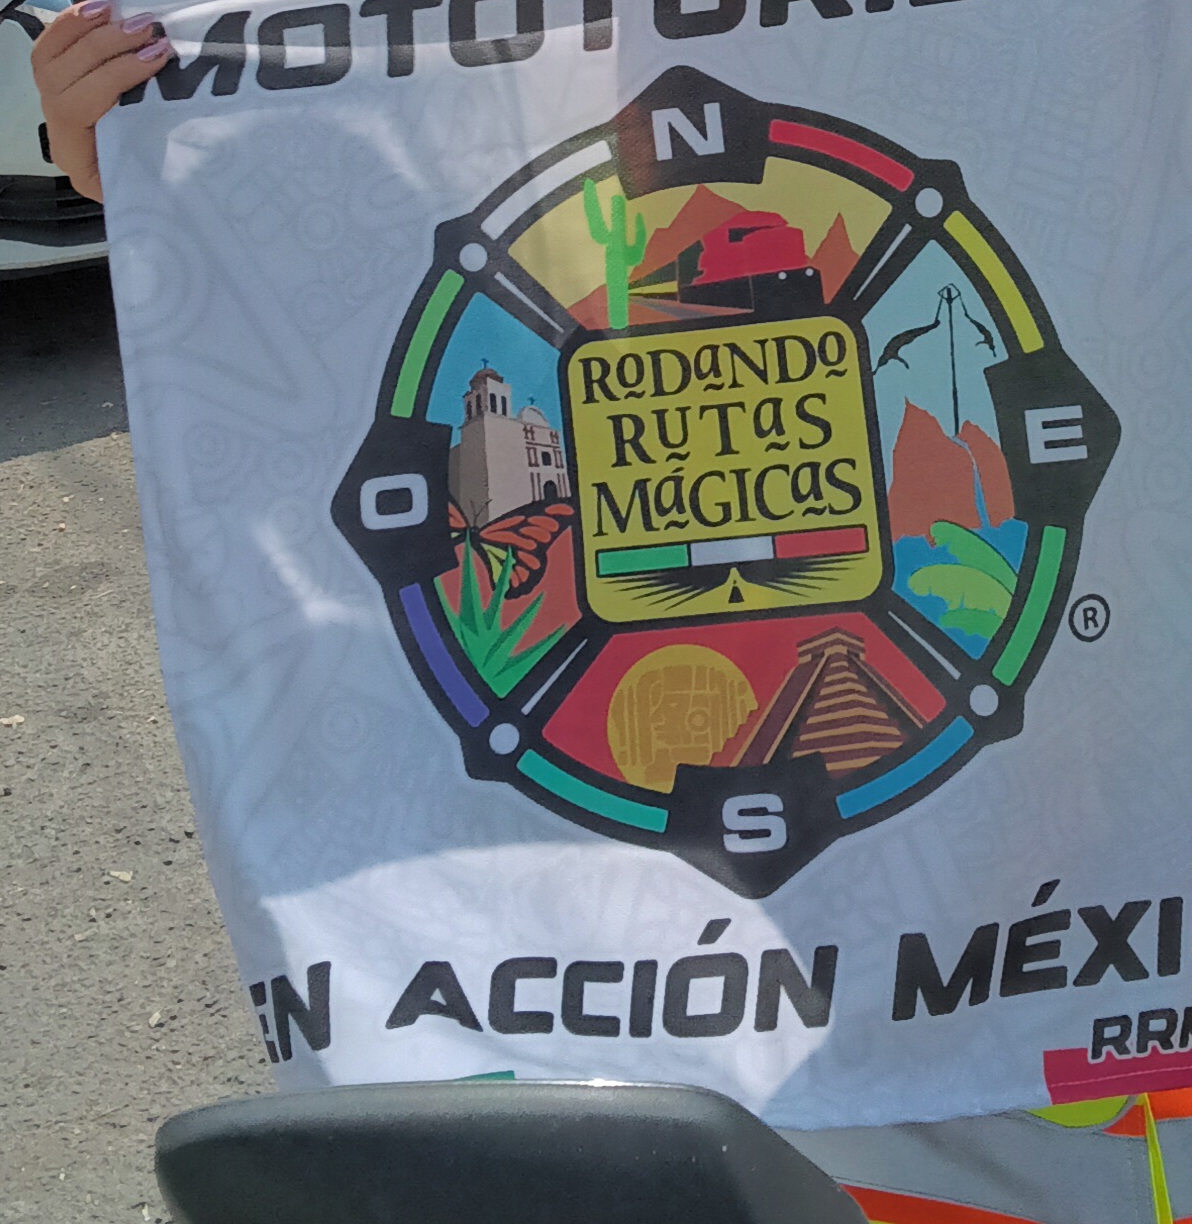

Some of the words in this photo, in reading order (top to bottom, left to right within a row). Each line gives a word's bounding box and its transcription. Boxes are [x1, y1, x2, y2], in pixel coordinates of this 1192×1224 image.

[651, 102, 725, 161] N
[1024, 405, 1088, 463] E
[360, 473, 428, 530] O
[721, 793, 788, 854] S
[385, 918, 839, 1038] ACCIÓN
